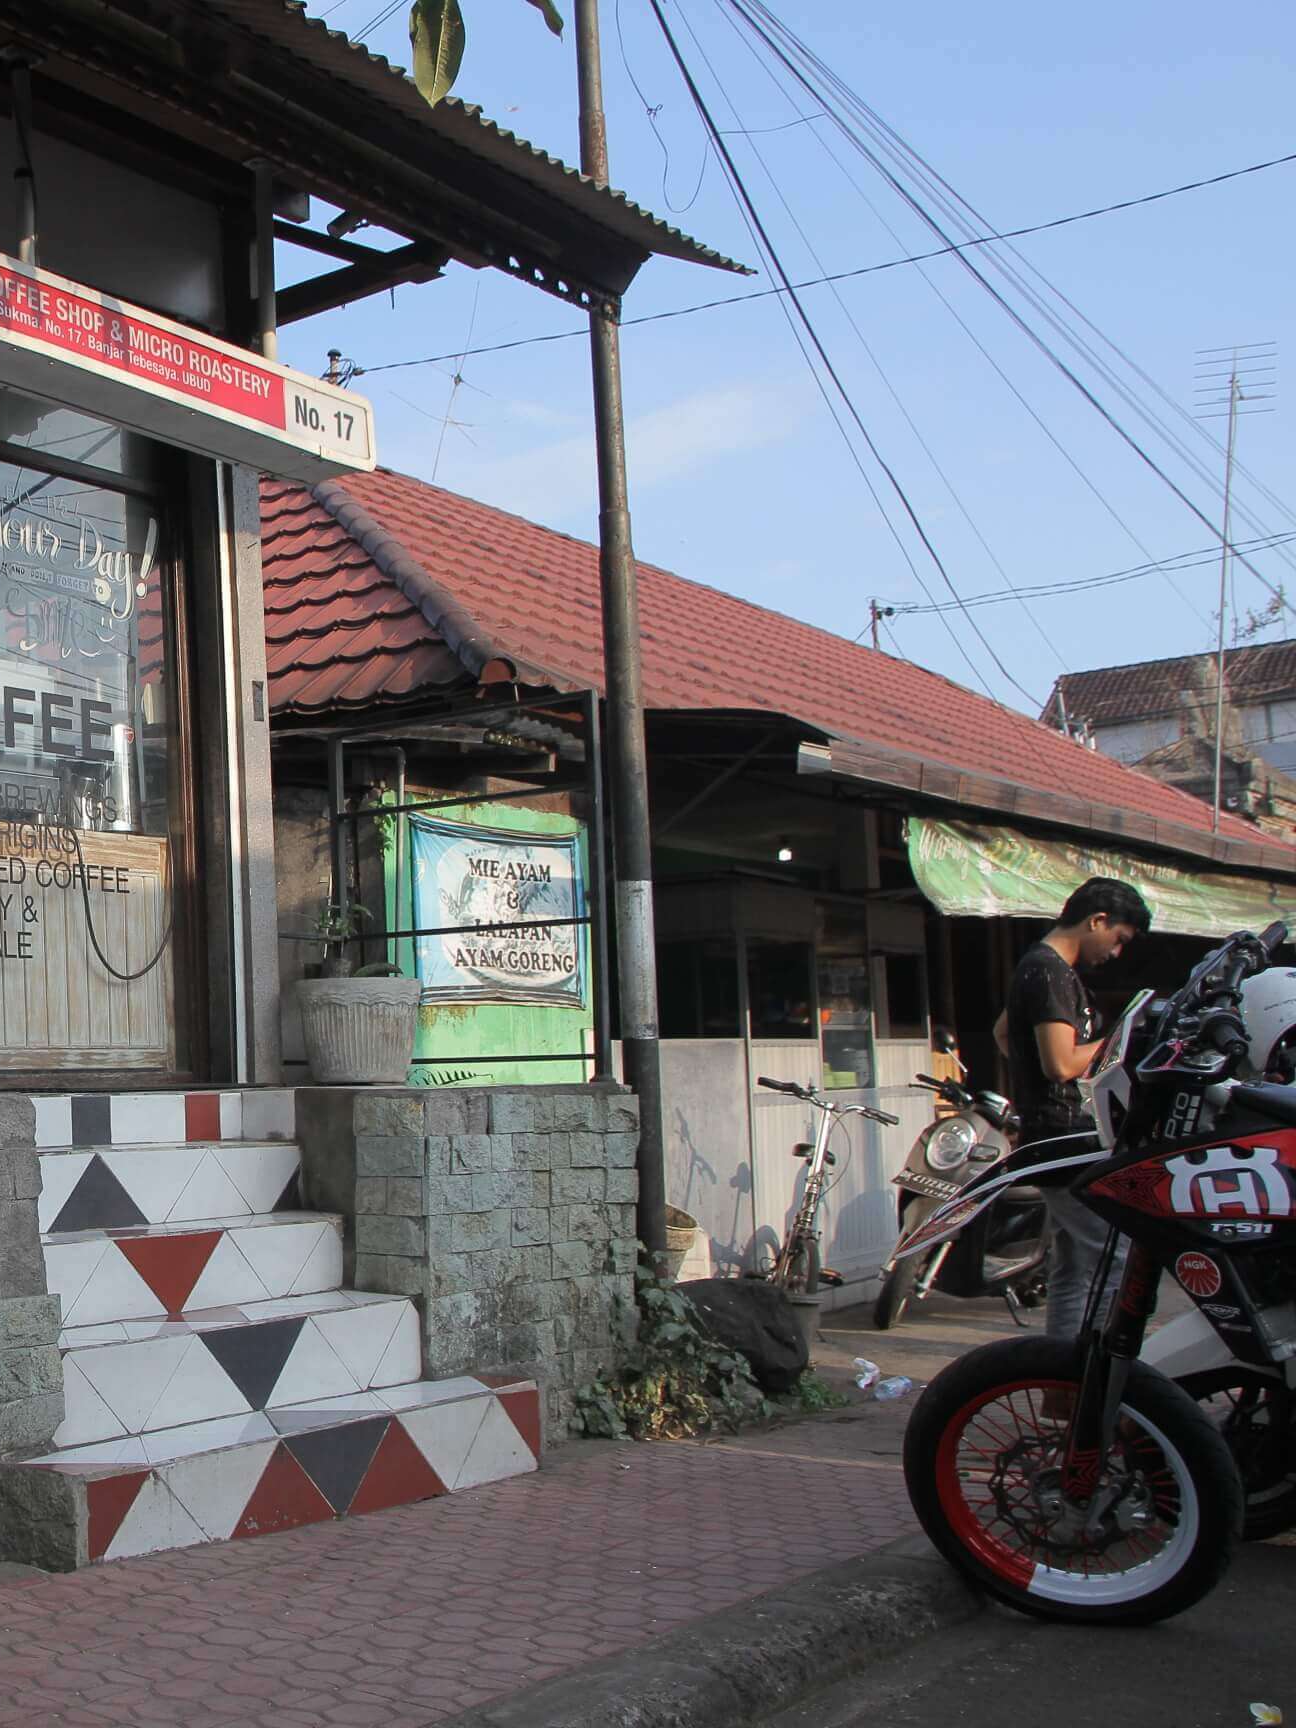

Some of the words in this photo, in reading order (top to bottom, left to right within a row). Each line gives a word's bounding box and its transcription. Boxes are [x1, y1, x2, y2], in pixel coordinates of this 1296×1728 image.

[45, 319, 65, 338] No.
[88, 335, 124, 361] Banjar
[182, 371, 211, 393] UBUD
[55, 298, 104, 333] SHOP
[110, 320, 123, 343] &
[128, 325, 183, 366] MICRO
[189, 350, 271, 398] ROASTERY
[294, 395, 325, 433] No.
[333, 412, 354, 441] 17
[73, 517, 158, 620] Day!
[35, 859, 131, 894] COFFEE
[468, 857, 500, 879] MIE
[504, 862, 551, 883] AYAM
[23, 895, 38, 923] &
[506, 891, 520, 910] &
[475, 917, 553, 942] LALAPAN
[455, 947, 506, 968] AYAM
[507, 950, 574, 973] GORENG
